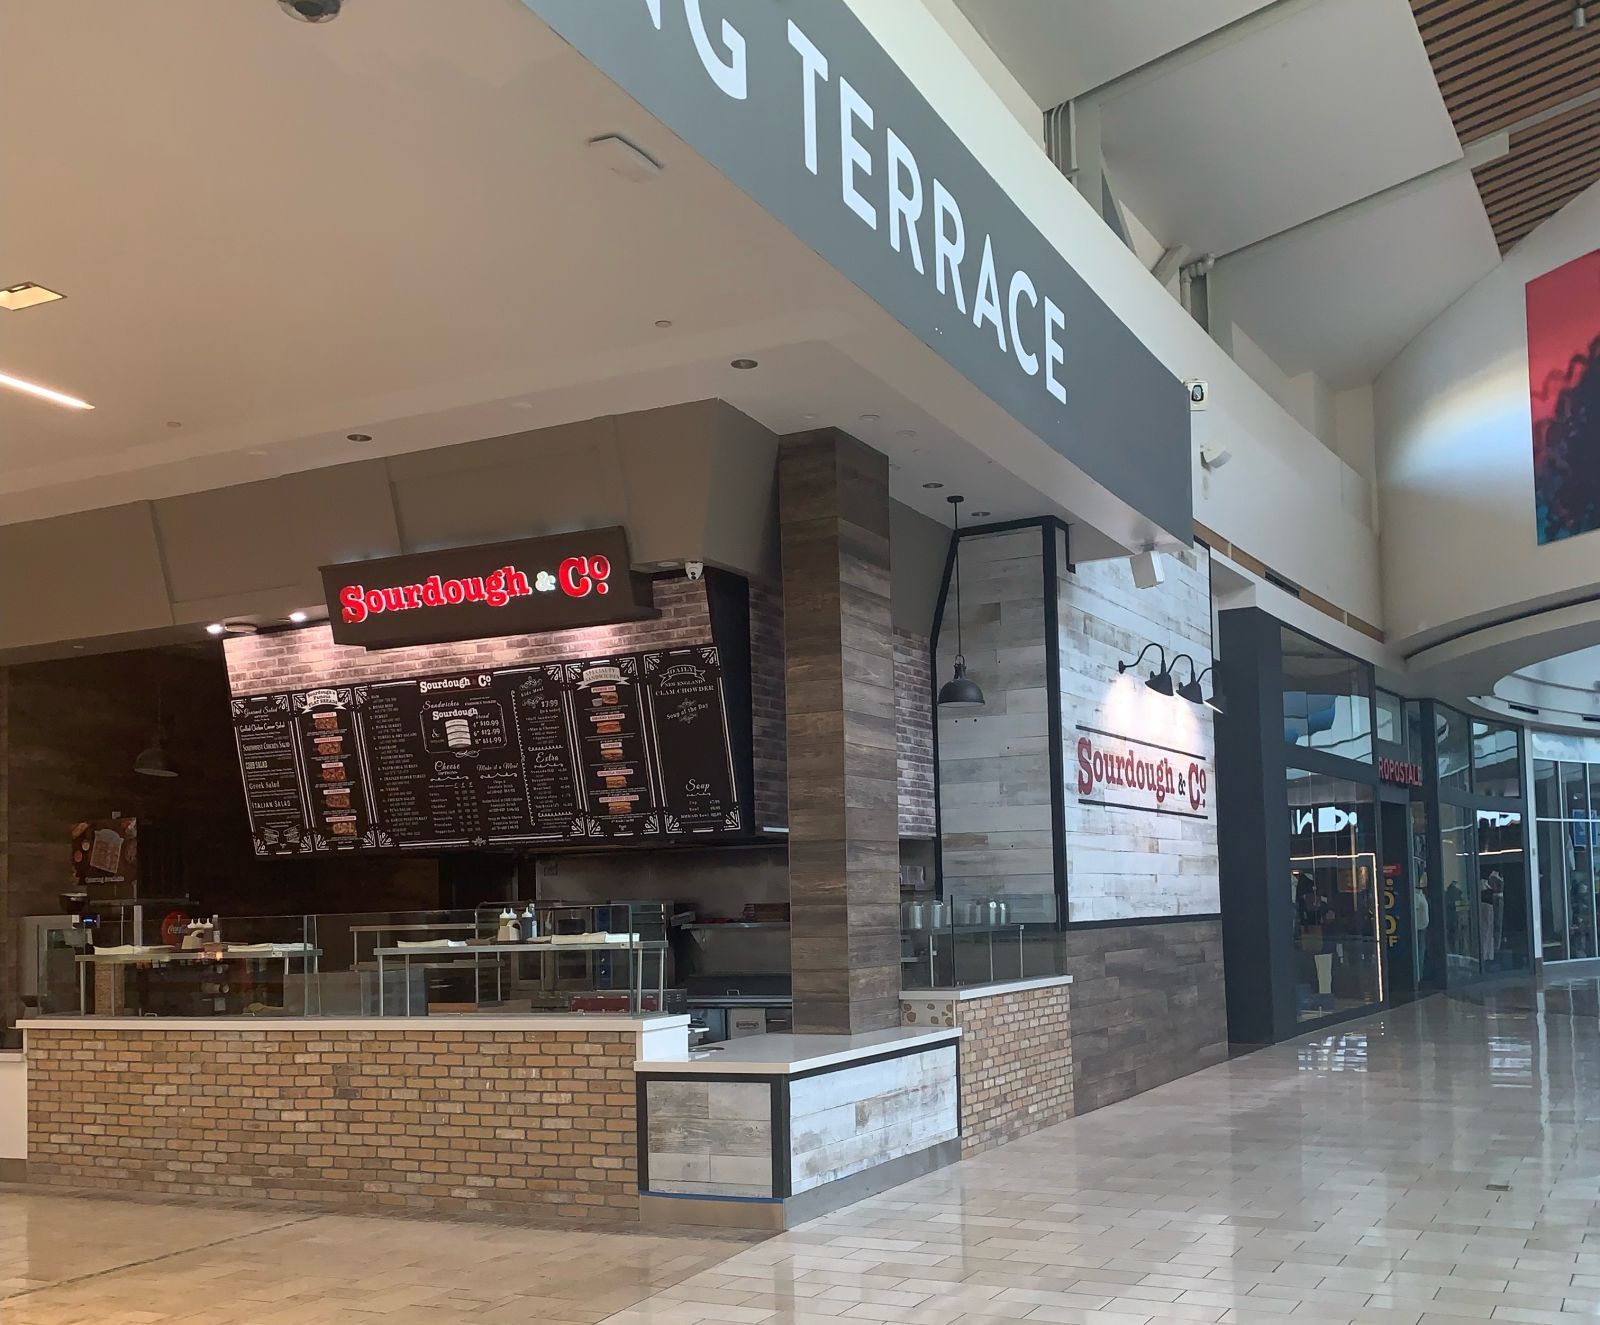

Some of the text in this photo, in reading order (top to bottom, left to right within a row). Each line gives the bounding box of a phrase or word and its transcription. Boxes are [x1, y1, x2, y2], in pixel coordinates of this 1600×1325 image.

[788, 18, 1067, 404] TERRACE
[339, 565, 532, 623] Sourdough
[535, 571, 556, 592] &
[670, 666, 693, 674] DAILY
[420, 677, 471, 693] Sourdough
[656, 685, 714, 696] CLAM CHOWDER
[432, 708, 478, 720] Sourdough
[435, 760, 460, 771] Cheese
[1077, 737, 1175, 803] Sourdough
[1178, 772, 1186, 796] &
[249, 780, 280, 790] Greek Salad
[686, 779, 710, 792] Soup
[252, 801, 273, 809] ITALIAN
